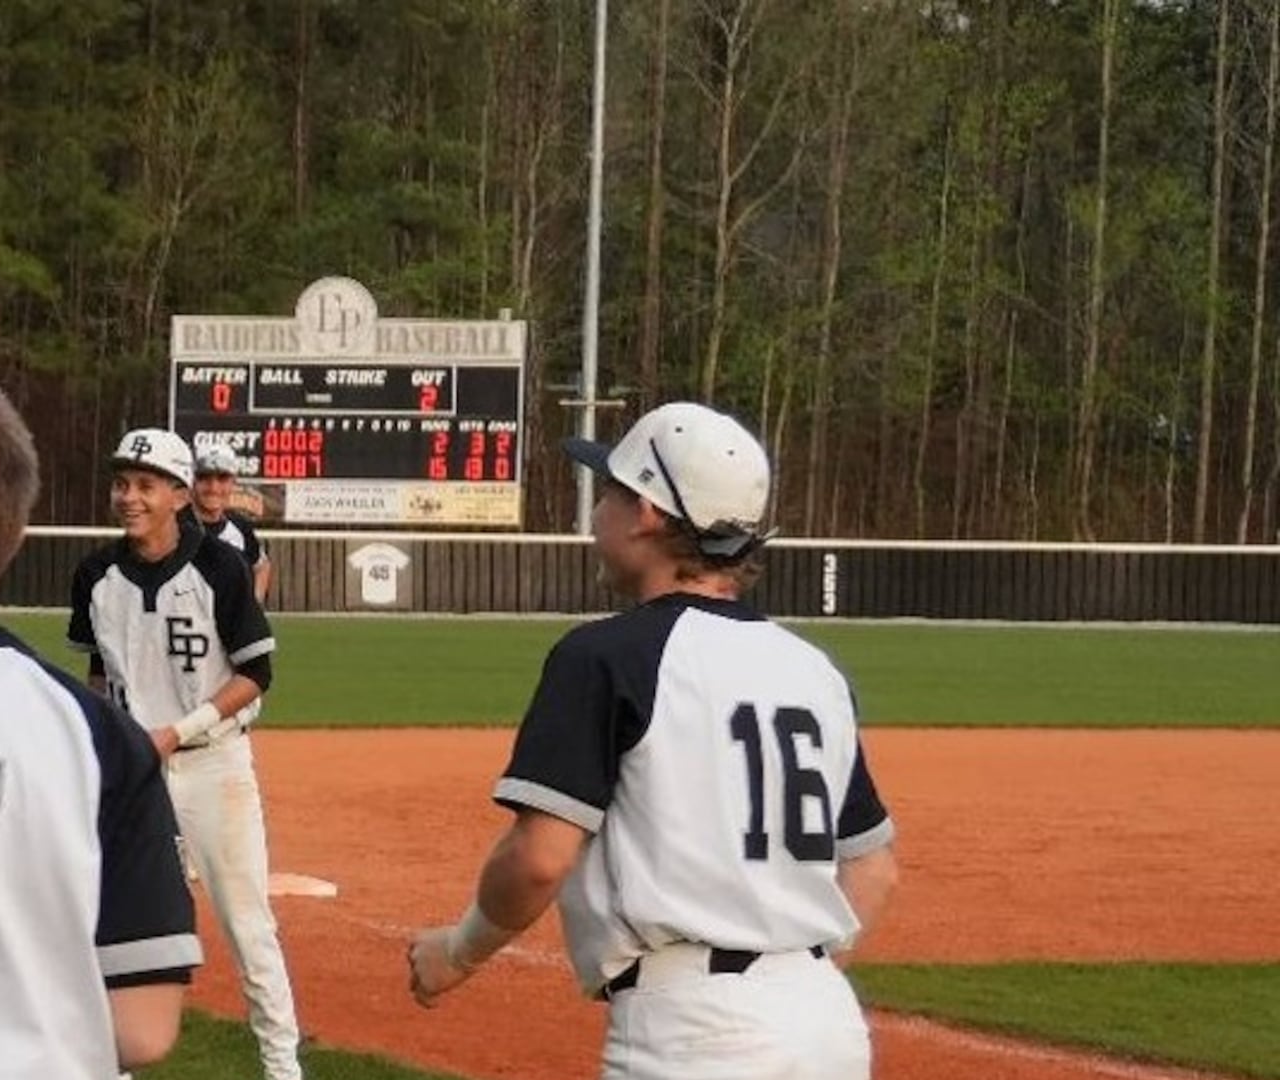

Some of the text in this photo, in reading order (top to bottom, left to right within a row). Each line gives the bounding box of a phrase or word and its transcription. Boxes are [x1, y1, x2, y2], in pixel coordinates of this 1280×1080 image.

[376, 326, 513, 355] BASEBALL
[182, 368, 247, 384] BATTER
[260, 369, 447, 386] BALL STRIKE OUT
[212, 384, 231, 411] 0
[420, 386, 437, 412] 2
[194, 431, 260, 450] GUEST
[166, 617, 209, 672] EP
[730, 704, 834, 860] 16
